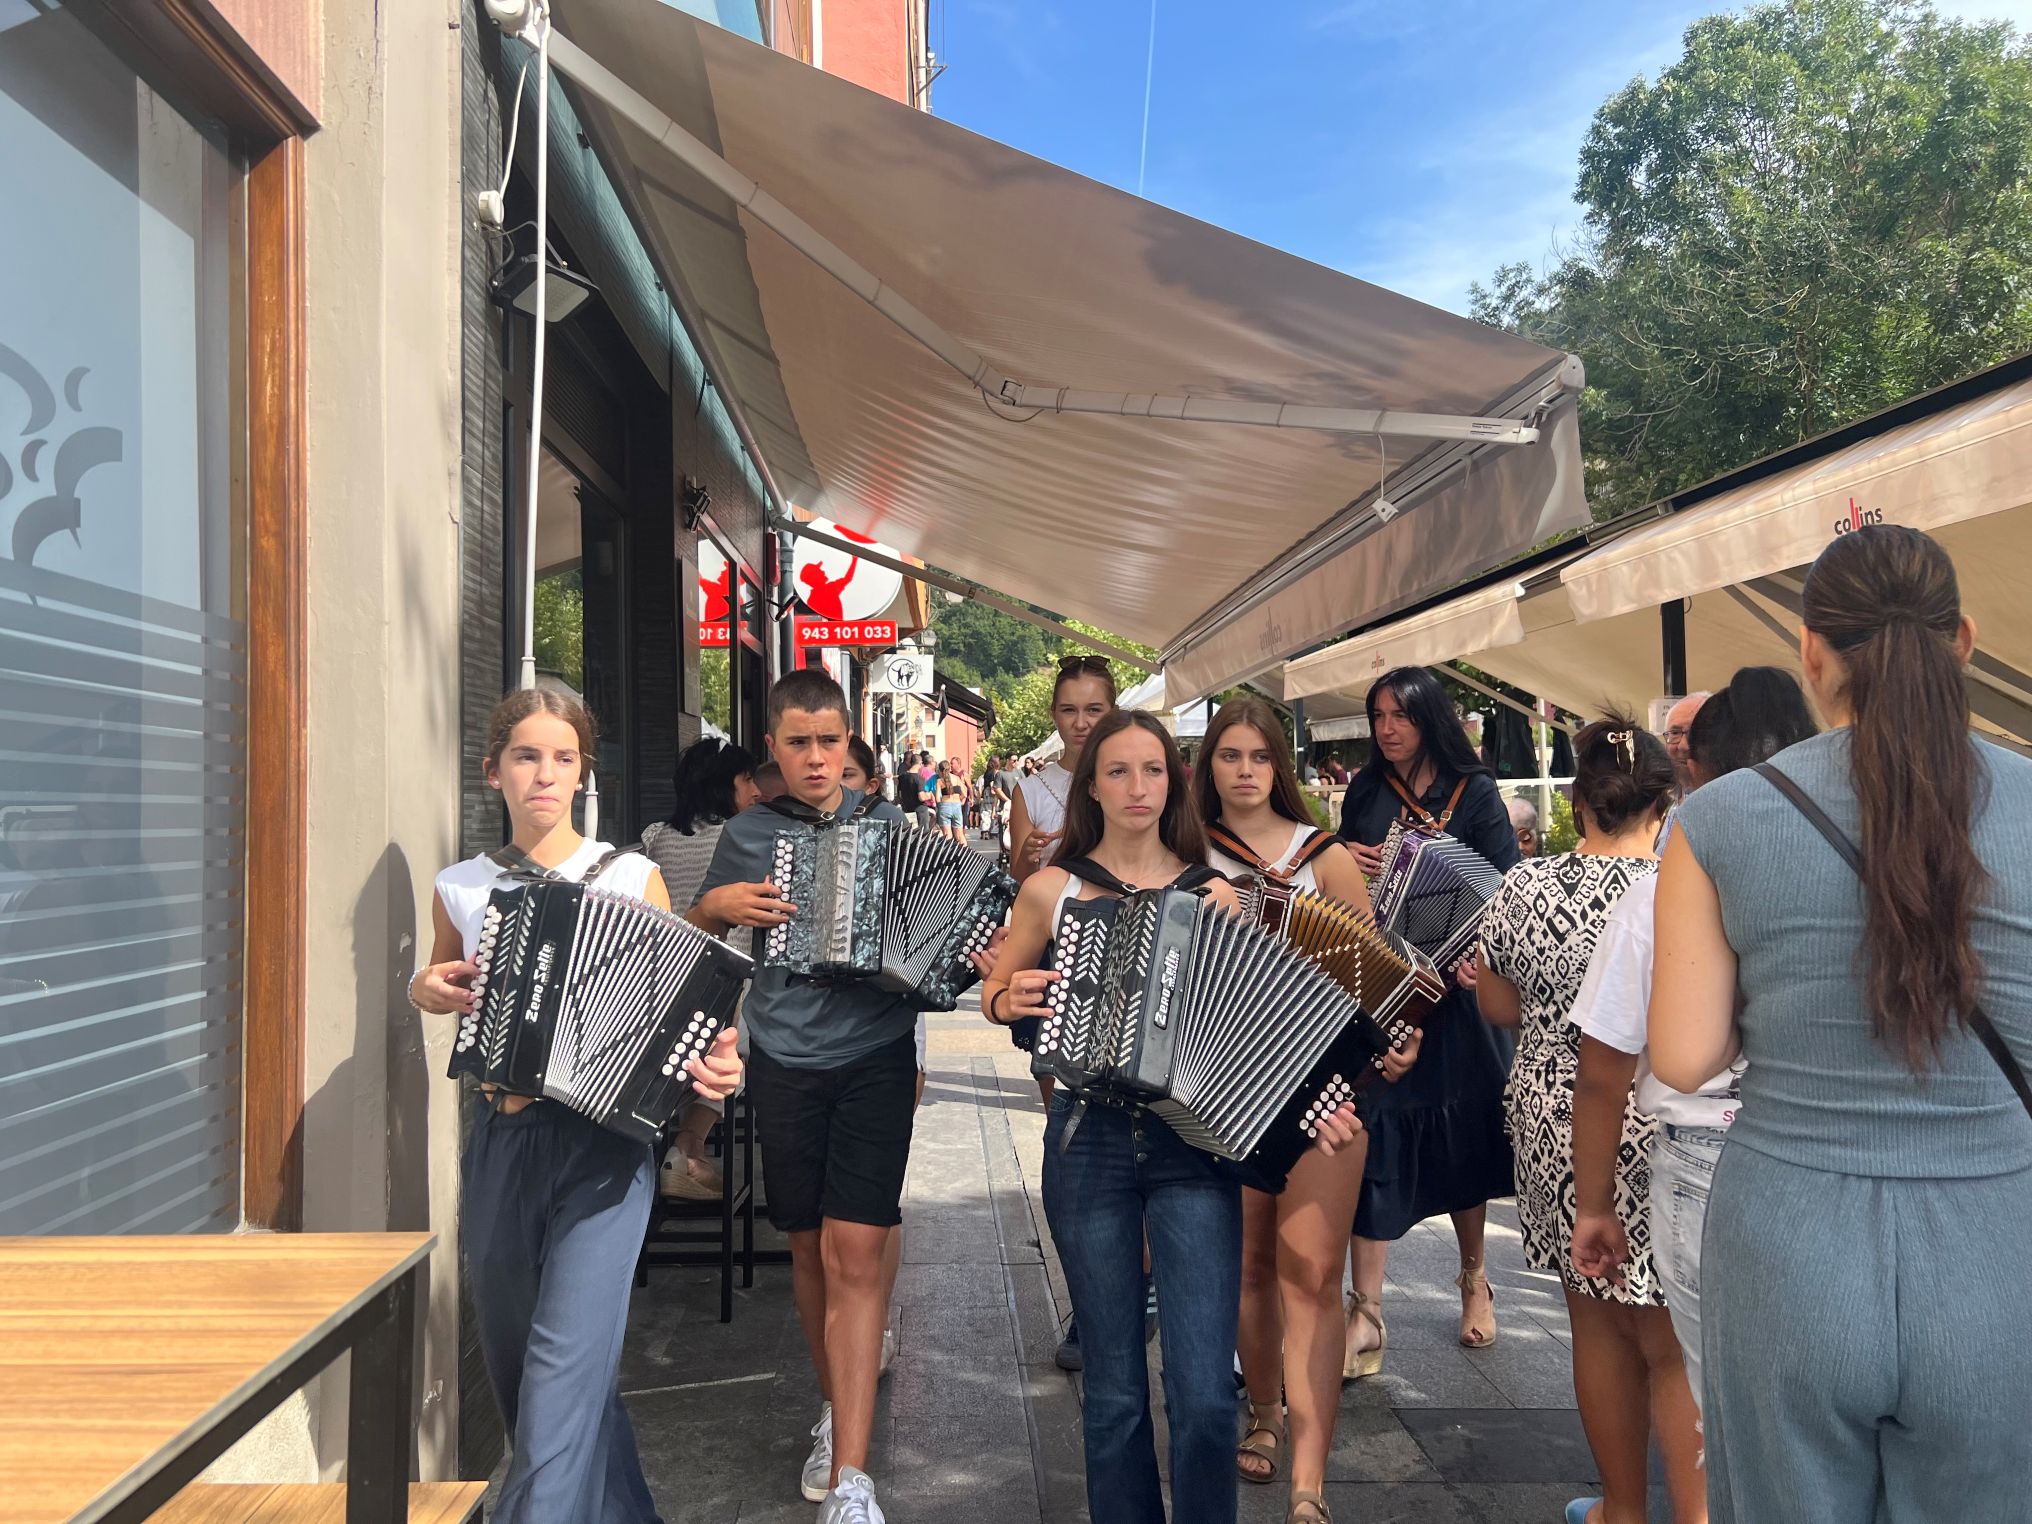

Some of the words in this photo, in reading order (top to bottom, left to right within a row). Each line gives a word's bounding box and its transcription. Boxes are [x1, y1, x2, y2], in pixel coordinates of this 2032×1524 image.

[1834, 497, 1883, 535] collins
[802, 627, 829, 640] 943
[834, 626, 859, 639] 101
[864, 625, 891, 639] 033
[533, 943, 553, 984] Sette
[1161, 949, 1178, 988] Sette
